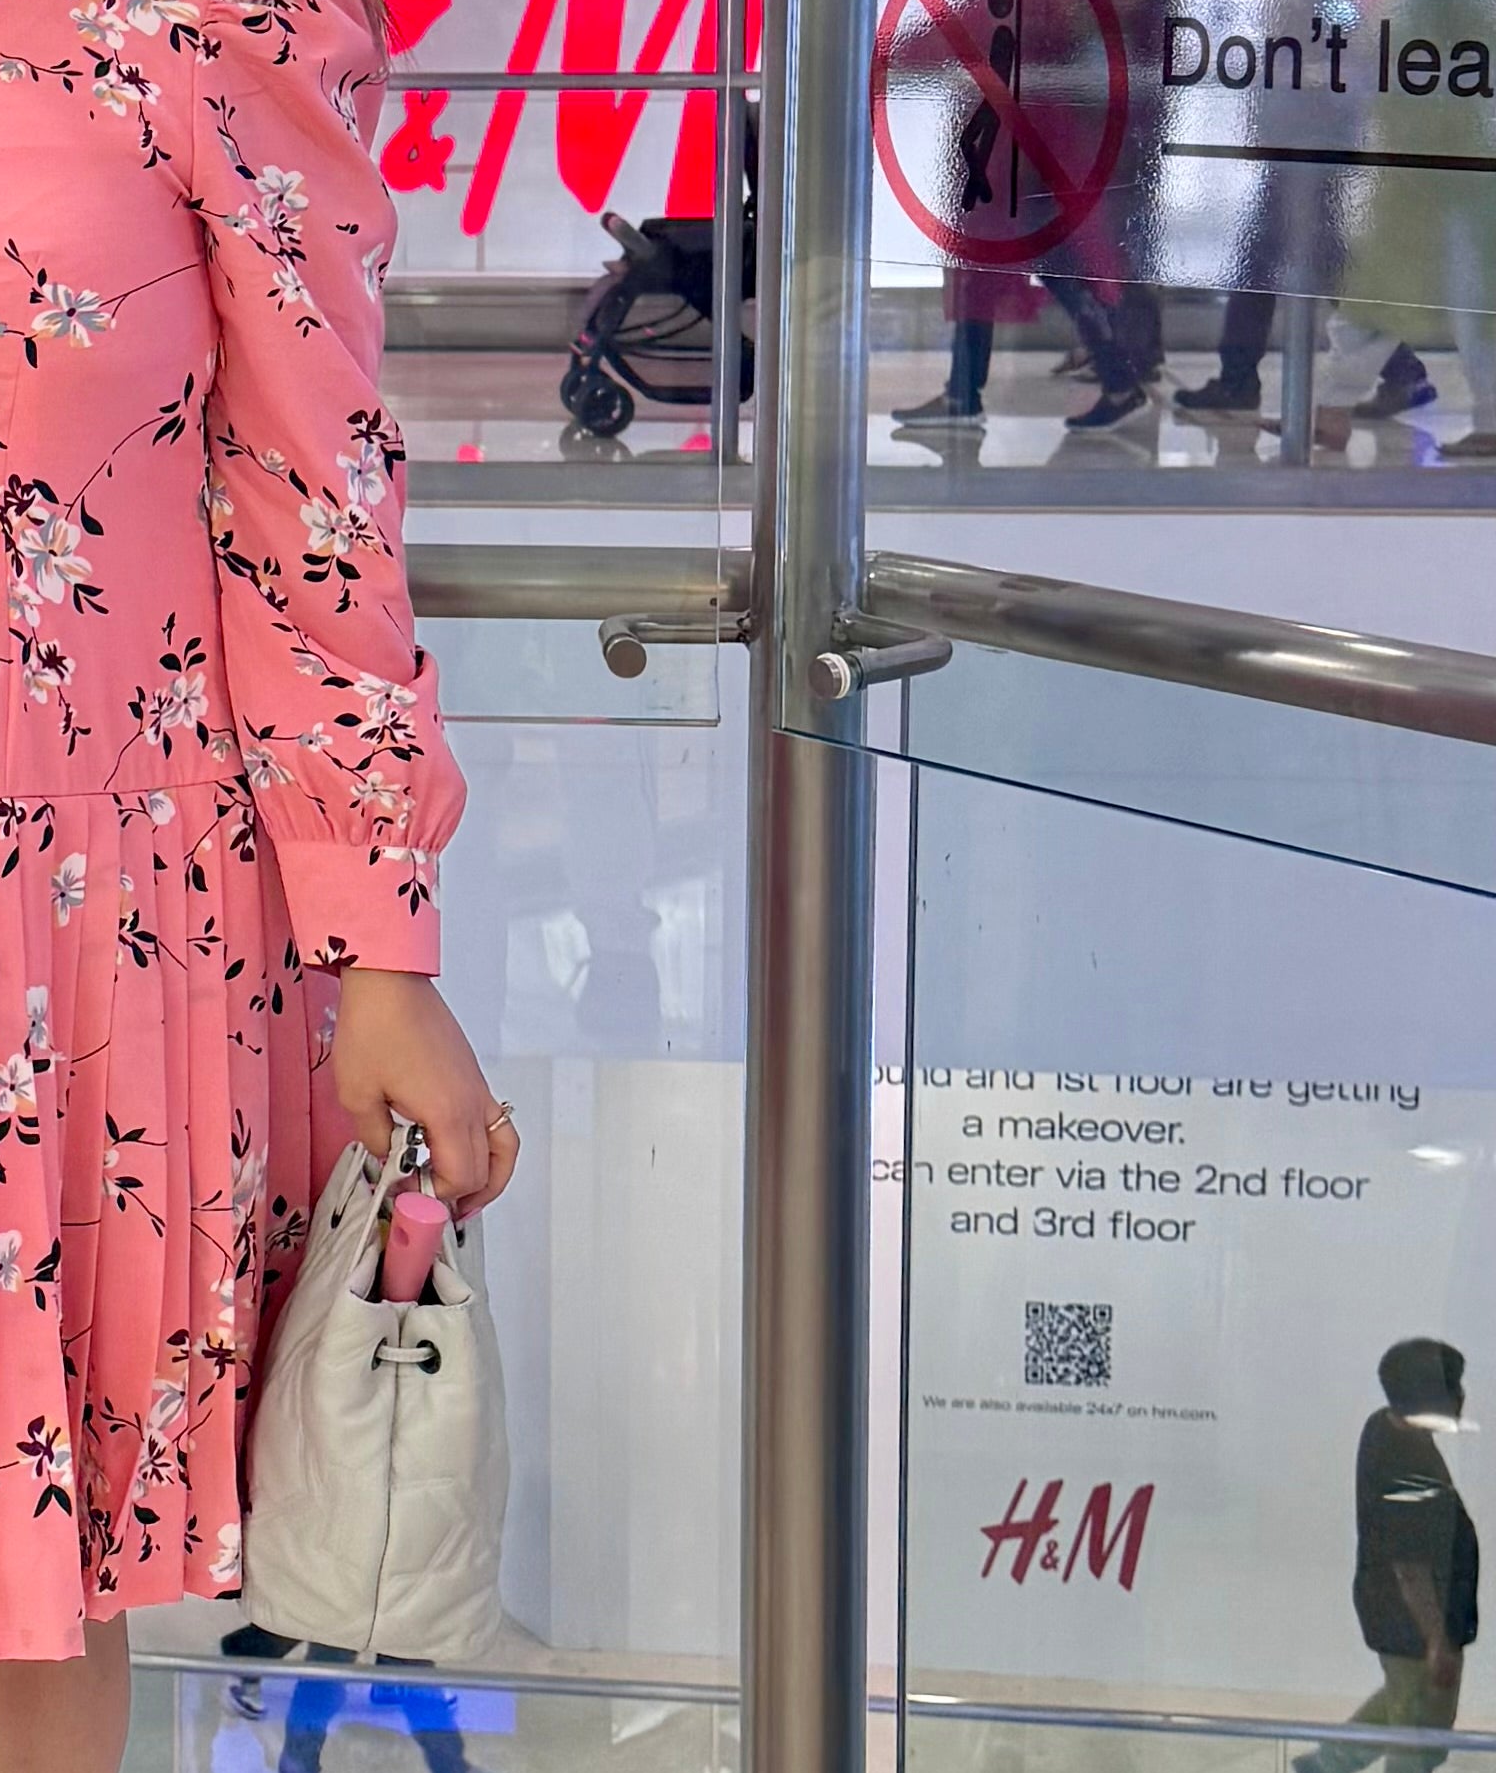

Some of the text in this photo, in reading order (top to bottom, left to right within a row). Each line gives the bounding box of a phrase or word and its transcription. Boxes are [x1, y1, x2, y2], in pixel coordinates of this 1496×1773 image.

[1161, 15, 1495, 98] Don't lea
[1212, 1078, 1273, 1098] are
[962, 1111, 1186, 1145] a makeover.
[947, 1159, 1045, 1189] enter
[1055, 1159, 1106, 1191] via
[1119, 1162, 1181, 1194] the
[1194, 1163, 1268, 1197] 2nd
[1279, 1166, 1371, 1201] floor
[950, 1207, 1196, 1243] and 3rd floor
[922, 1394, 947, 1409] We
[950, 1397, 975, 1410] are
[978, 1396, 1011, 1412] also
[1014, 1399, 1083, 1415] available
[1126, 1405, 1149, 1418] on
[979, 1477, 1155, 1593] H&M
